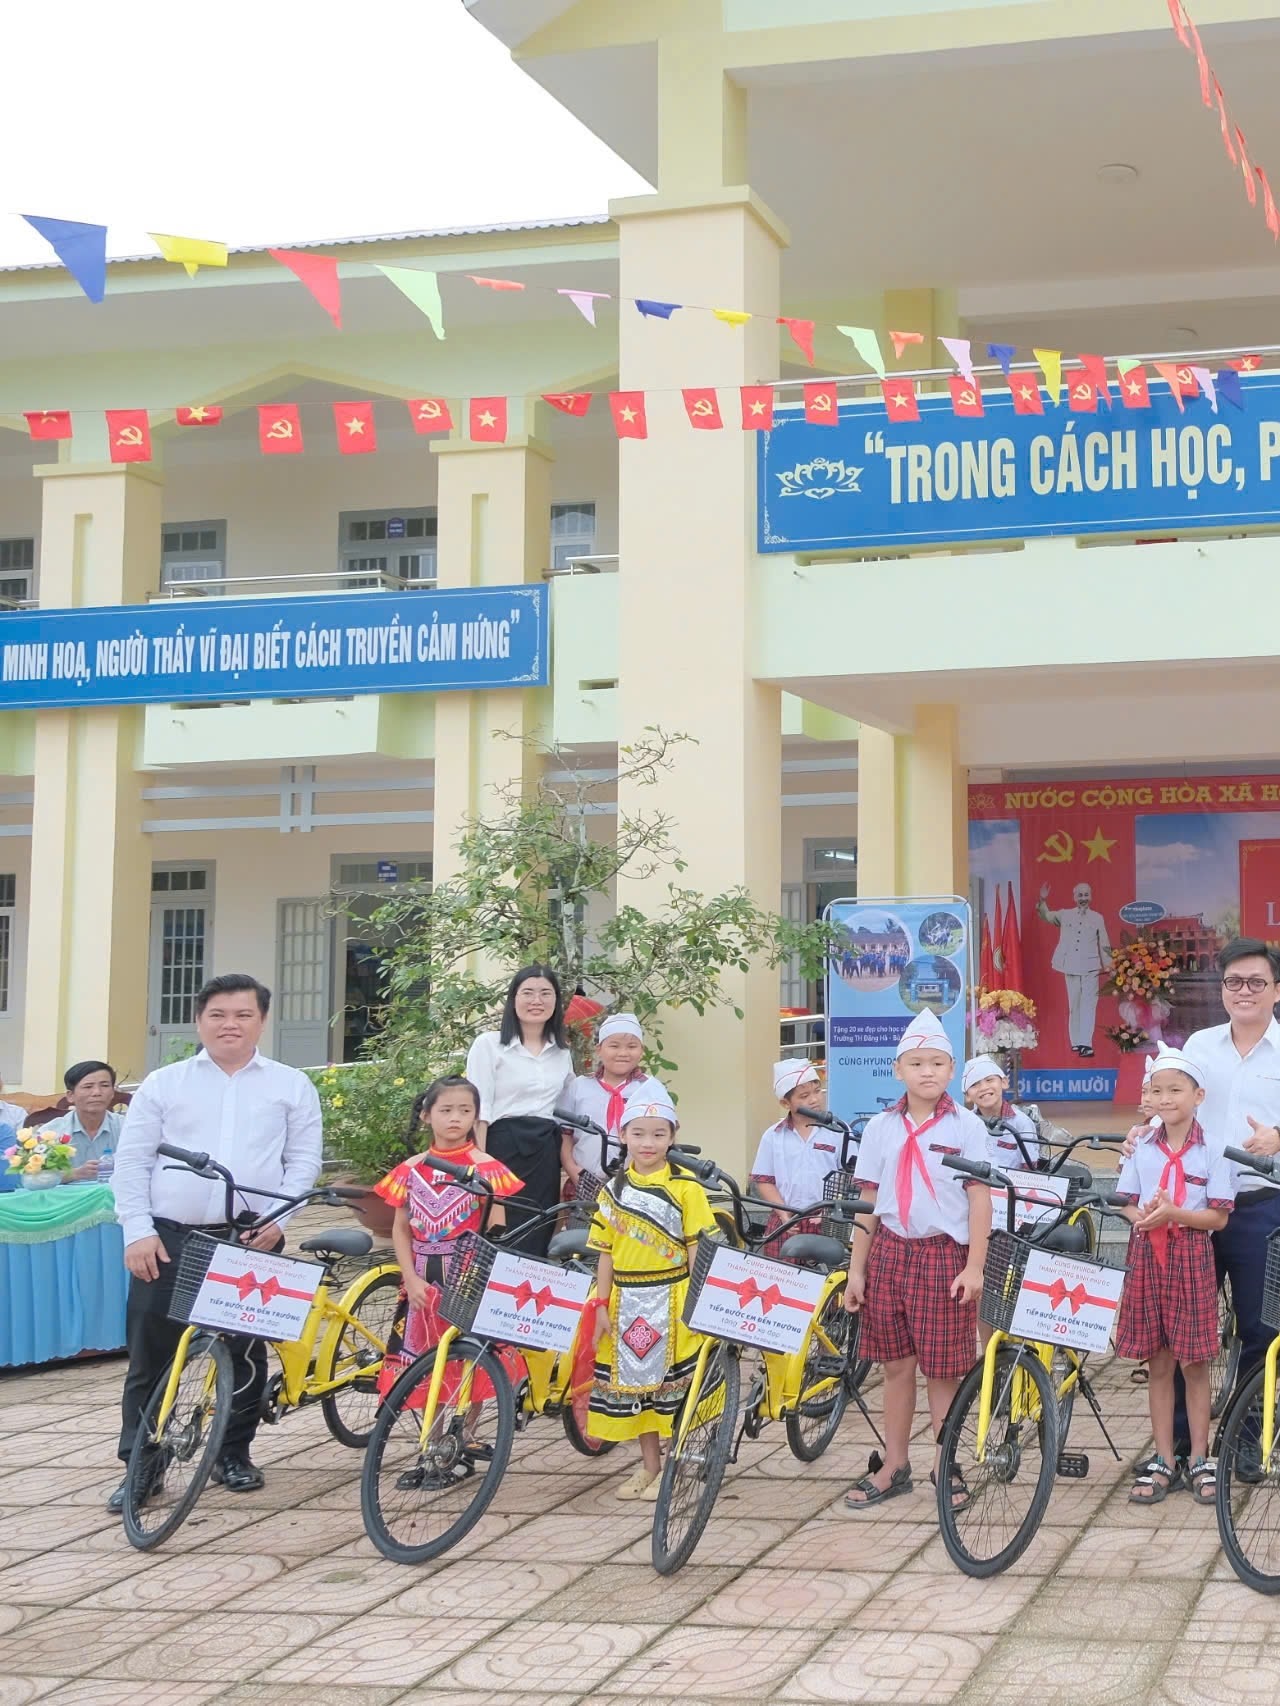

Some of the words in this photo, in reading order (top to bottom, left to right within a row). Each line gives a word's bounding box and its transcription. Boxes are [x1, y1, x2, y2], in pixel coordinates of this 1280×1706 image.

[864, 431, 1016, 504] “TRONG
[1030, 418, 1138, 495] CÁCH
[1150, 423, 1245, 500] HỌC,
[3, 643, 48, 681] MINH
[52, 641, 90, 687] HOẠ,
[96, 629, 149, 677] NGƯỜI
[153, 623, 195, 674] THẦY
[200, 627, 218, 672] VĨ
[220, 633, 249, 679] ĐẠI
[253, 620, 291, 671] BIẾT
[295, 622, 341, 668] CÁCH
[346, 613, 412, 666] TRUYỀN
[417, 610, 457, 662] CẢM
[462, 609, 520, 660] HỨNG”
[1004, 786, 1075, 809] NƯỚC
[1081, 785, 1153, 808] CỘNG
[1159, 780, 1210, 805] HÒA
[1218, 780, 1254, 802] XÃ
[838, 1056, 862, 1066] CÙNG
[872, 1067, 893, 1077] BÌNH
[1036, 1077, 1063, 1093] ÍCH
[1068, 1075, 1109, 1093] MƯỜI
[240, 1312, 255, 1323] 20
[709, 1302, 724, 1312] TIẾP
[725, 1306, 745, 1319] BƯỚC
[746, 1313, 756, 1322] EM
[757, 1314, 772, 1326] ĐẾN
[773, 1320, 802, 1334] TRƯỜNG
[516, 1323, 531, 1334] 20
[740, 1320, 756, 1333] 20
[1053, 1323, 1067, 1334] 20
